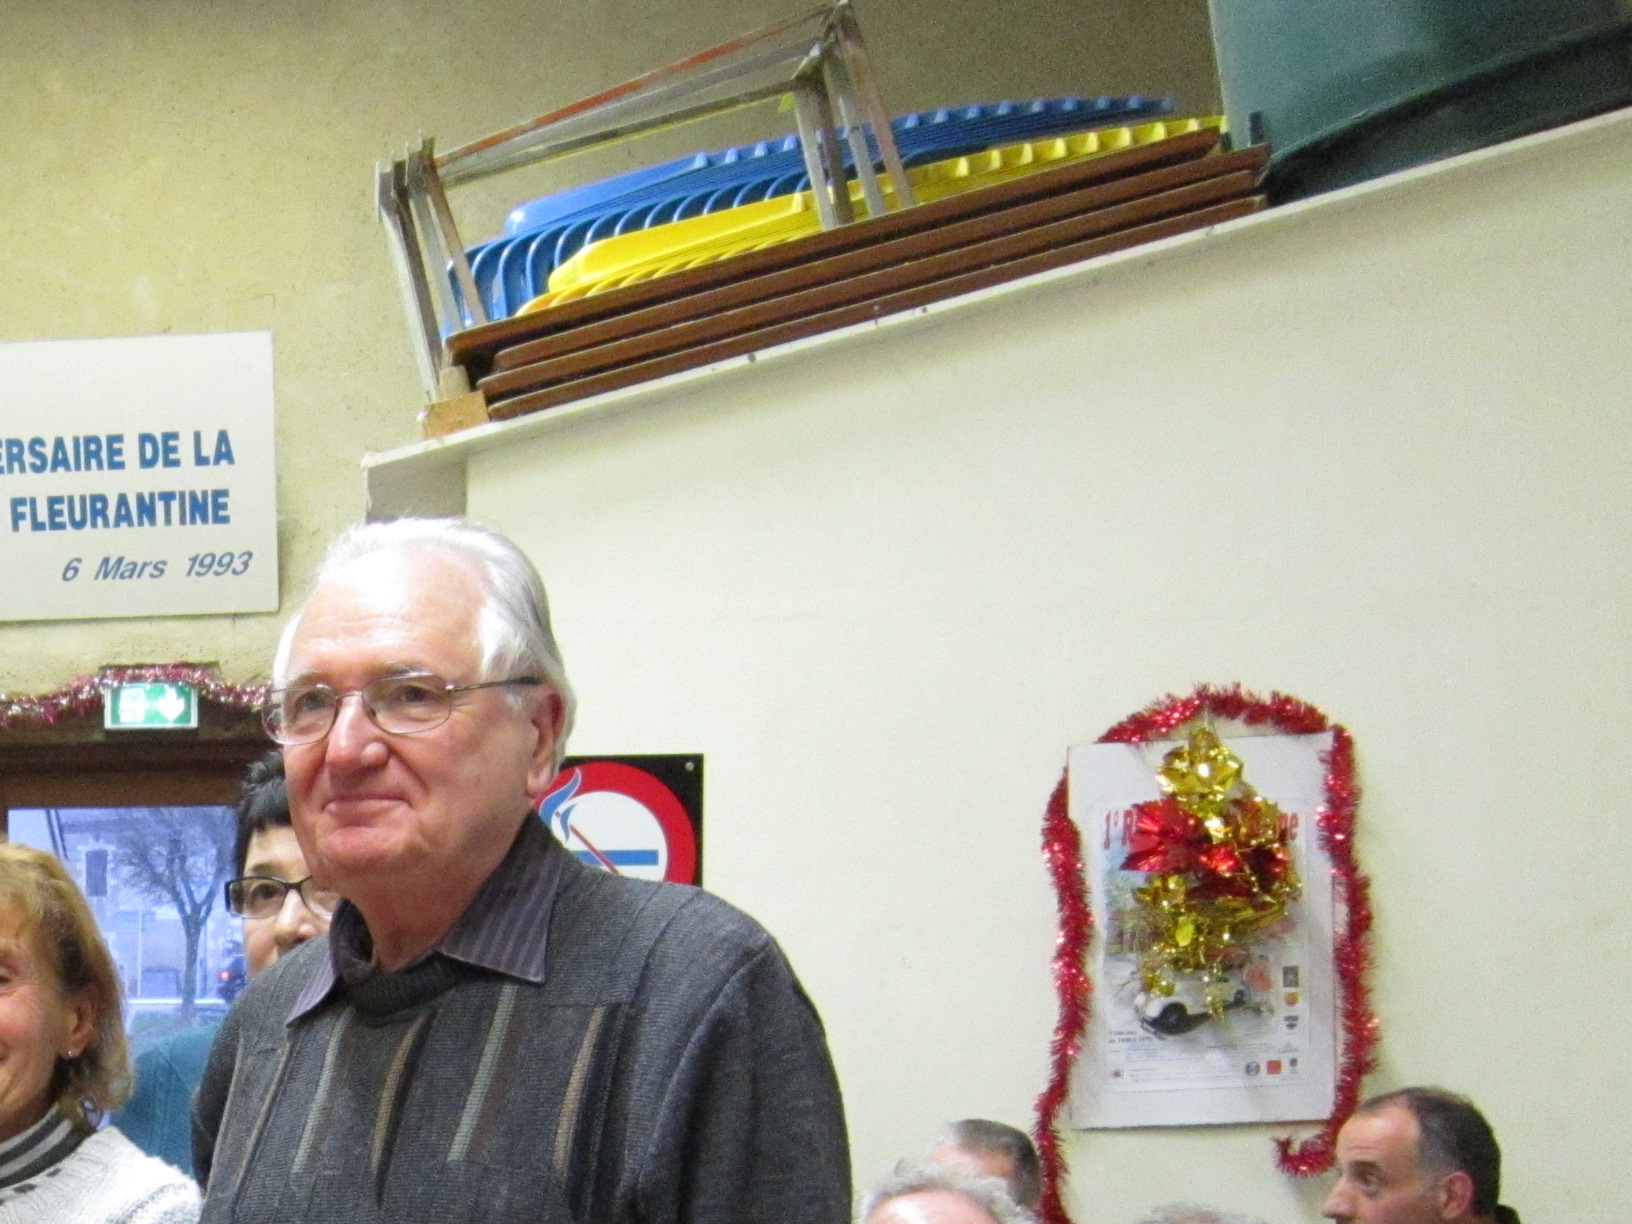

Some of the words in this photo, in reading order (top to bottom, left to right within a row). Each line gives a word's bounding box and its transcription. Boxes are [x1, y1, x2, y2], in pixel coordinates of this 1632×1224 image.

[138, 431, 181, 470] DE
[194, 429, 235, 467] LA
[11, 489, 230, 533] FLEURANTINE
[62, 558, 81, 582] 6
[95, 555, 167, 581] Mars
[186, 550, 253, 578] 1993
